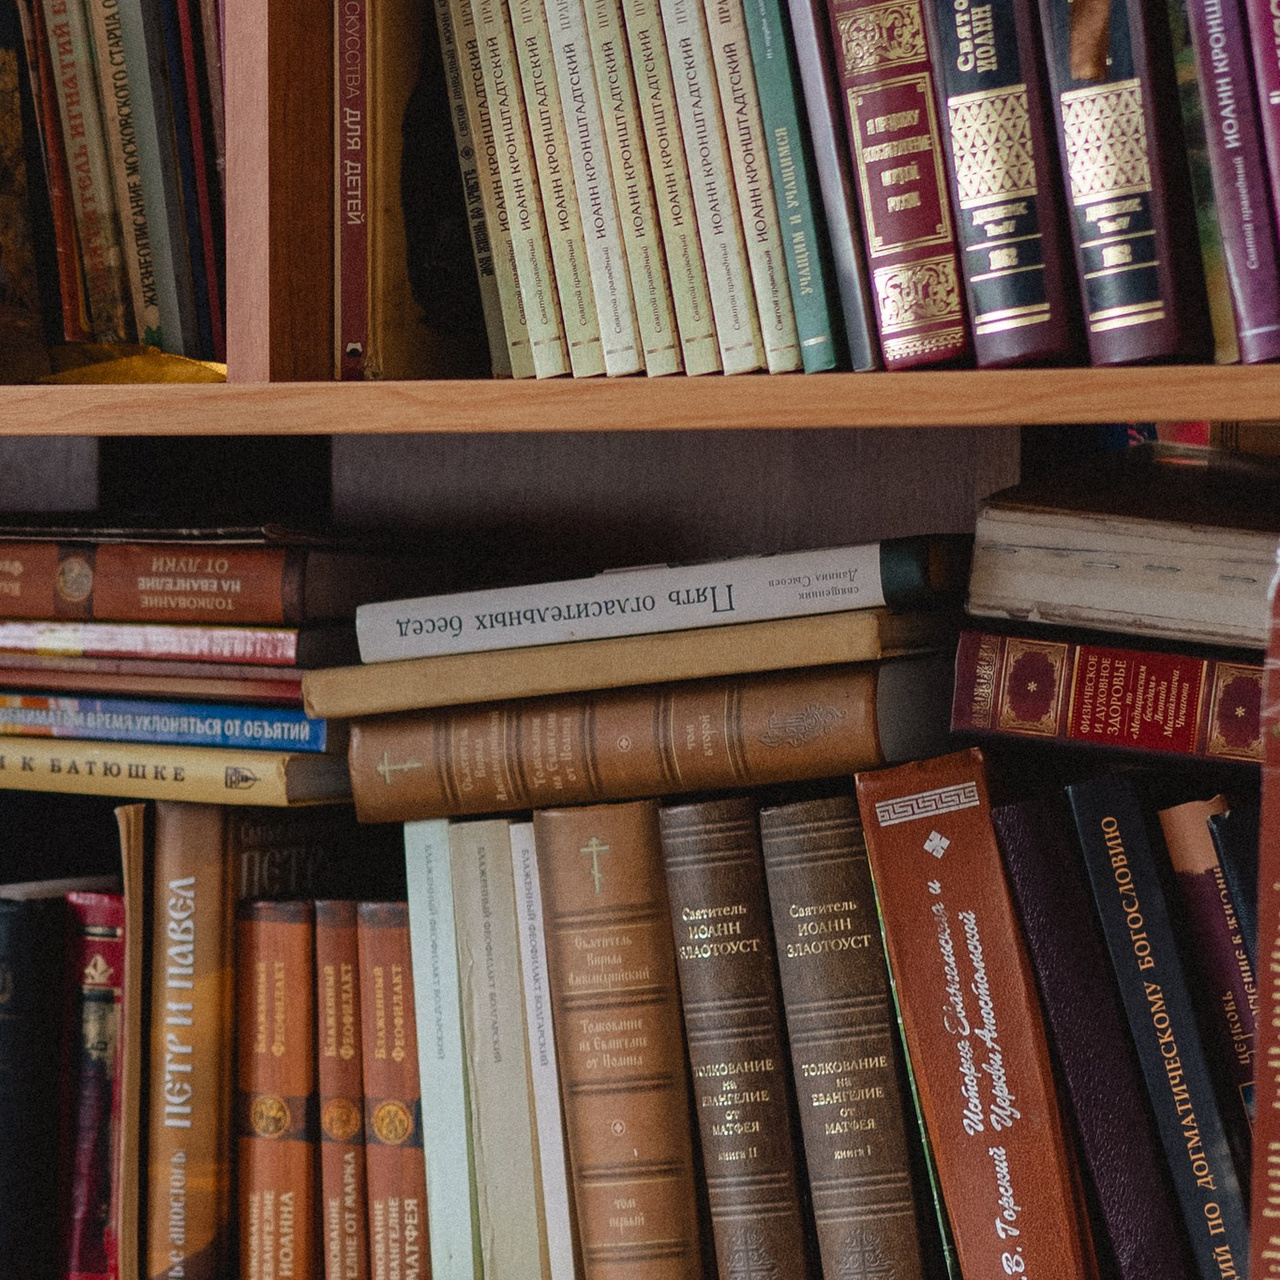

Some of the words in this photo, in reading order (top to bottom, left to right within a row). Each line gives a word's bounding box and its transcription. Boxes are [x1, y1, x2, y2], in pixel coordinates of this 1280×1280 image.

[104, 10, 127, 65] СТАРЦА
[969, 5, 997, 73] ИОАНН
[49, 22, 86, 139] ИГНАТИЙ
[677, 36, 719, 179] КРОНШТАДТСКИЙ
[721, 41, 763, 181] КРОНШТАДТСКИЙ
[110, 69, 144, 177] МОСКОВСКОГО
[342, 107, 362, 151] ДЛЯ
[1214, 78, 1241, 150] ИОАНН
[343, 159, 365, 225] ДЕТЕЙ
[704, 181, 726, 237] ИОАНН
[748, 185, 769, 243] ИОАНН
[395, 614, 463, 640] бесед
[474, 594, 655, 632] огласительных
[668, 583, 736, 612] Пять
[1080, 654, 1099, 734] ФИЗИЧЕСКОЕ
[1095, 657, 1111, 721] ДУХОВНОЕ
[1107, 659, 1127, 736] ЗДОРОВЬЕ
[135, 713, 222, 737] УКЛОНЯТЬСЯ
[224, 719, 242, 738] ОТ
[245, 720, 311, 741] ОБЪЯТИЙ
[21, 756, 36, 772] К
[49, 757, 188, 783] БАТЮШКЕ
[789, 900, 858, 918] Святитель
[1100, 815, 1157, 972] БОГОСЛОВИЮ
[166, 875, 197, 990] ПАВЕЛ
[797, 918, 852, 937] ИОАНН
[959, 909, 1001, 1050] Апостольской
[164, 1003, 192, 1027] И
[163, 1032, 193, 1130] ПЕТР
[801, 1056, 888, 1076] ТОЛКОВАНИЕ
[958, 1040, 985, 1136] История
[981, 1052, 1020, 1133] Церкви
[1143, 981, 1217, 1191] ДОГМАТИЧЕСКОМУ
[824, 1118, 876, 1135] МАТФЕЯ
[342, 1151, 358, 1208] МАРКА
[278, 1192, 295, 1276] ИОАННА
[1202, 1201, 1224, 1236] ПО
